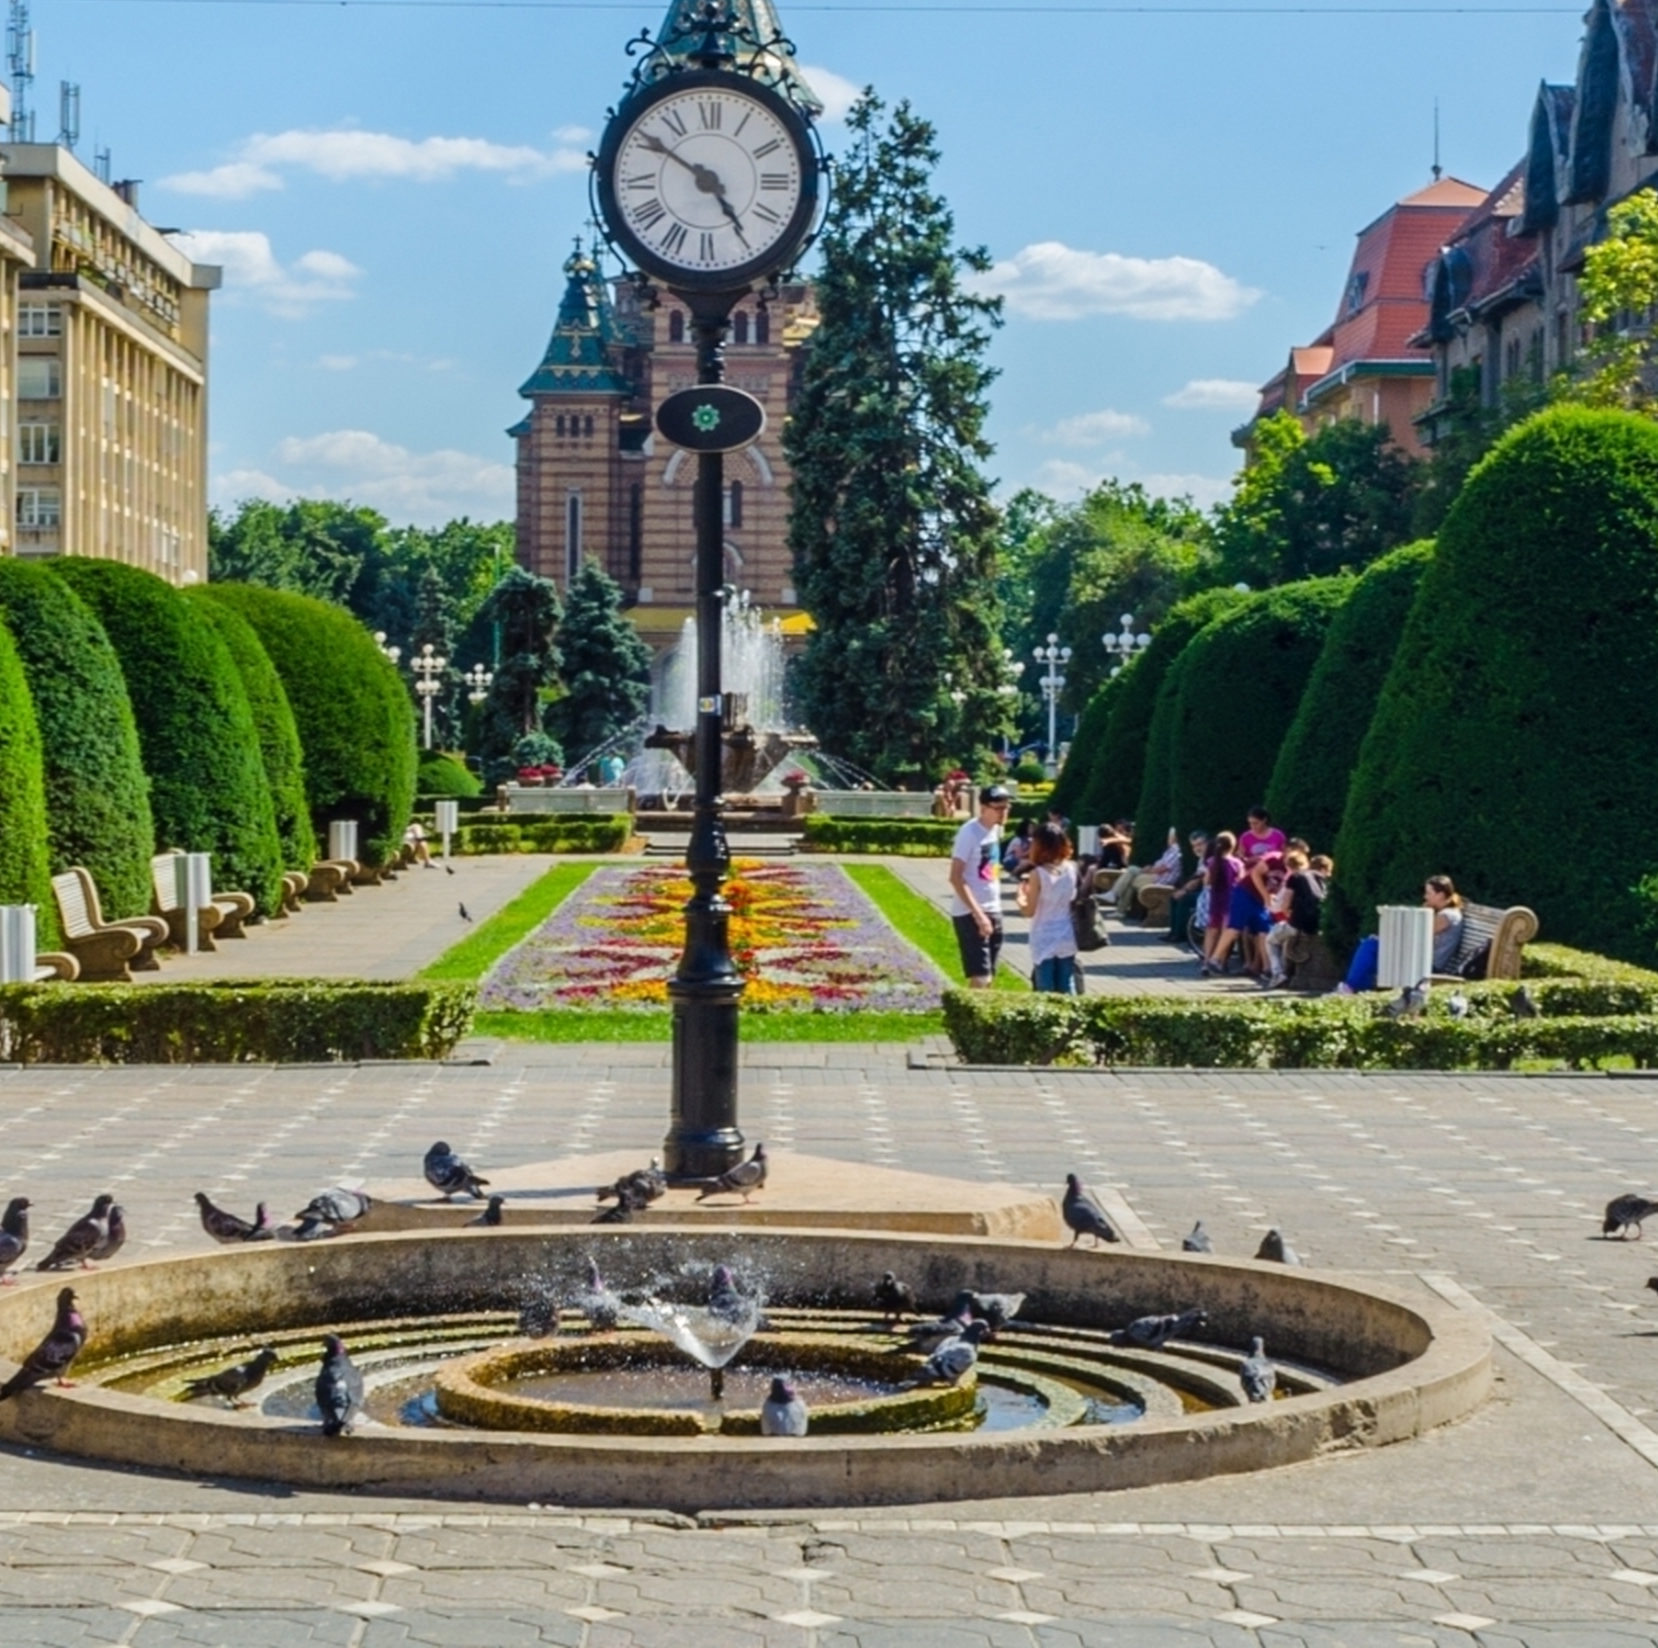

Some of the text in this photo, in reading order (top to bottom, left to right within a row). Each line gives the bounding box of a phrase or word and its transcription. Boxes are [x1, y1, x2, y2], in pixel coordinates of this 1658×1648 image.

[660, 109, 688, 141] XI
[697, 102, 722, 130] XII
[733, 111, 751, 137] I
[752, 138, 781, 159] II
[627, 172, 656, 190] IX
[760, 173, 789, 191] III
[632, 197, 667, 232] VIII
[751, 202, 782, 229] IV
[659, 222, 688, 255] VII
[699, 232, 715, 261] VI
